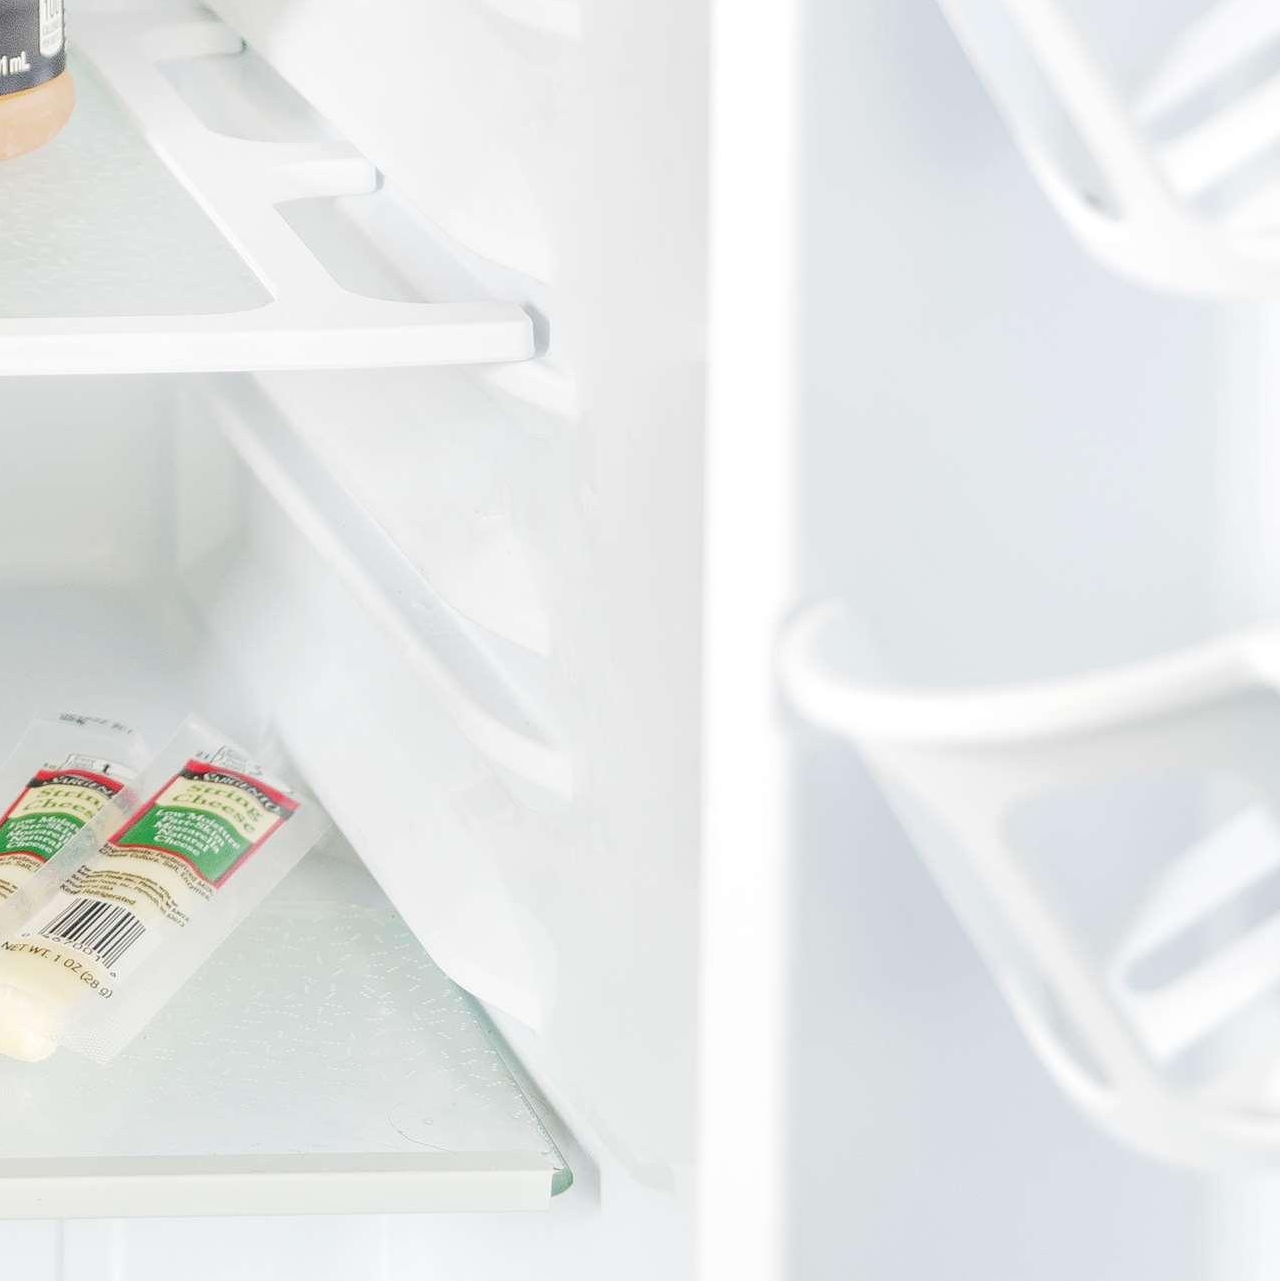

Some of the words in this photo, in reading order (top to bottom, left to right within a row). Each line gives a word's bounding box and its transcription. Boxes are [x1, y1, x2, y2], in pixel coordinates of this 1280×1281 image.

[9, 51, 31, 75] mL
[172, 794, 256, 833] Cheese
[187, 785, 263, 822] String
[153, 834, 202, 857] Cheese
[155, 809, 185, 818] Low
[187, 811, 242, 850] Moisture
[1, 941, 28, 952] NET
[29, 945, 50, 959] WT.
[53, 954, 62, 962] 1
[63, 958, 83, 974] OZ
[80, 970, 101, 989] (28
[98, 987, 114, 1000] g)
